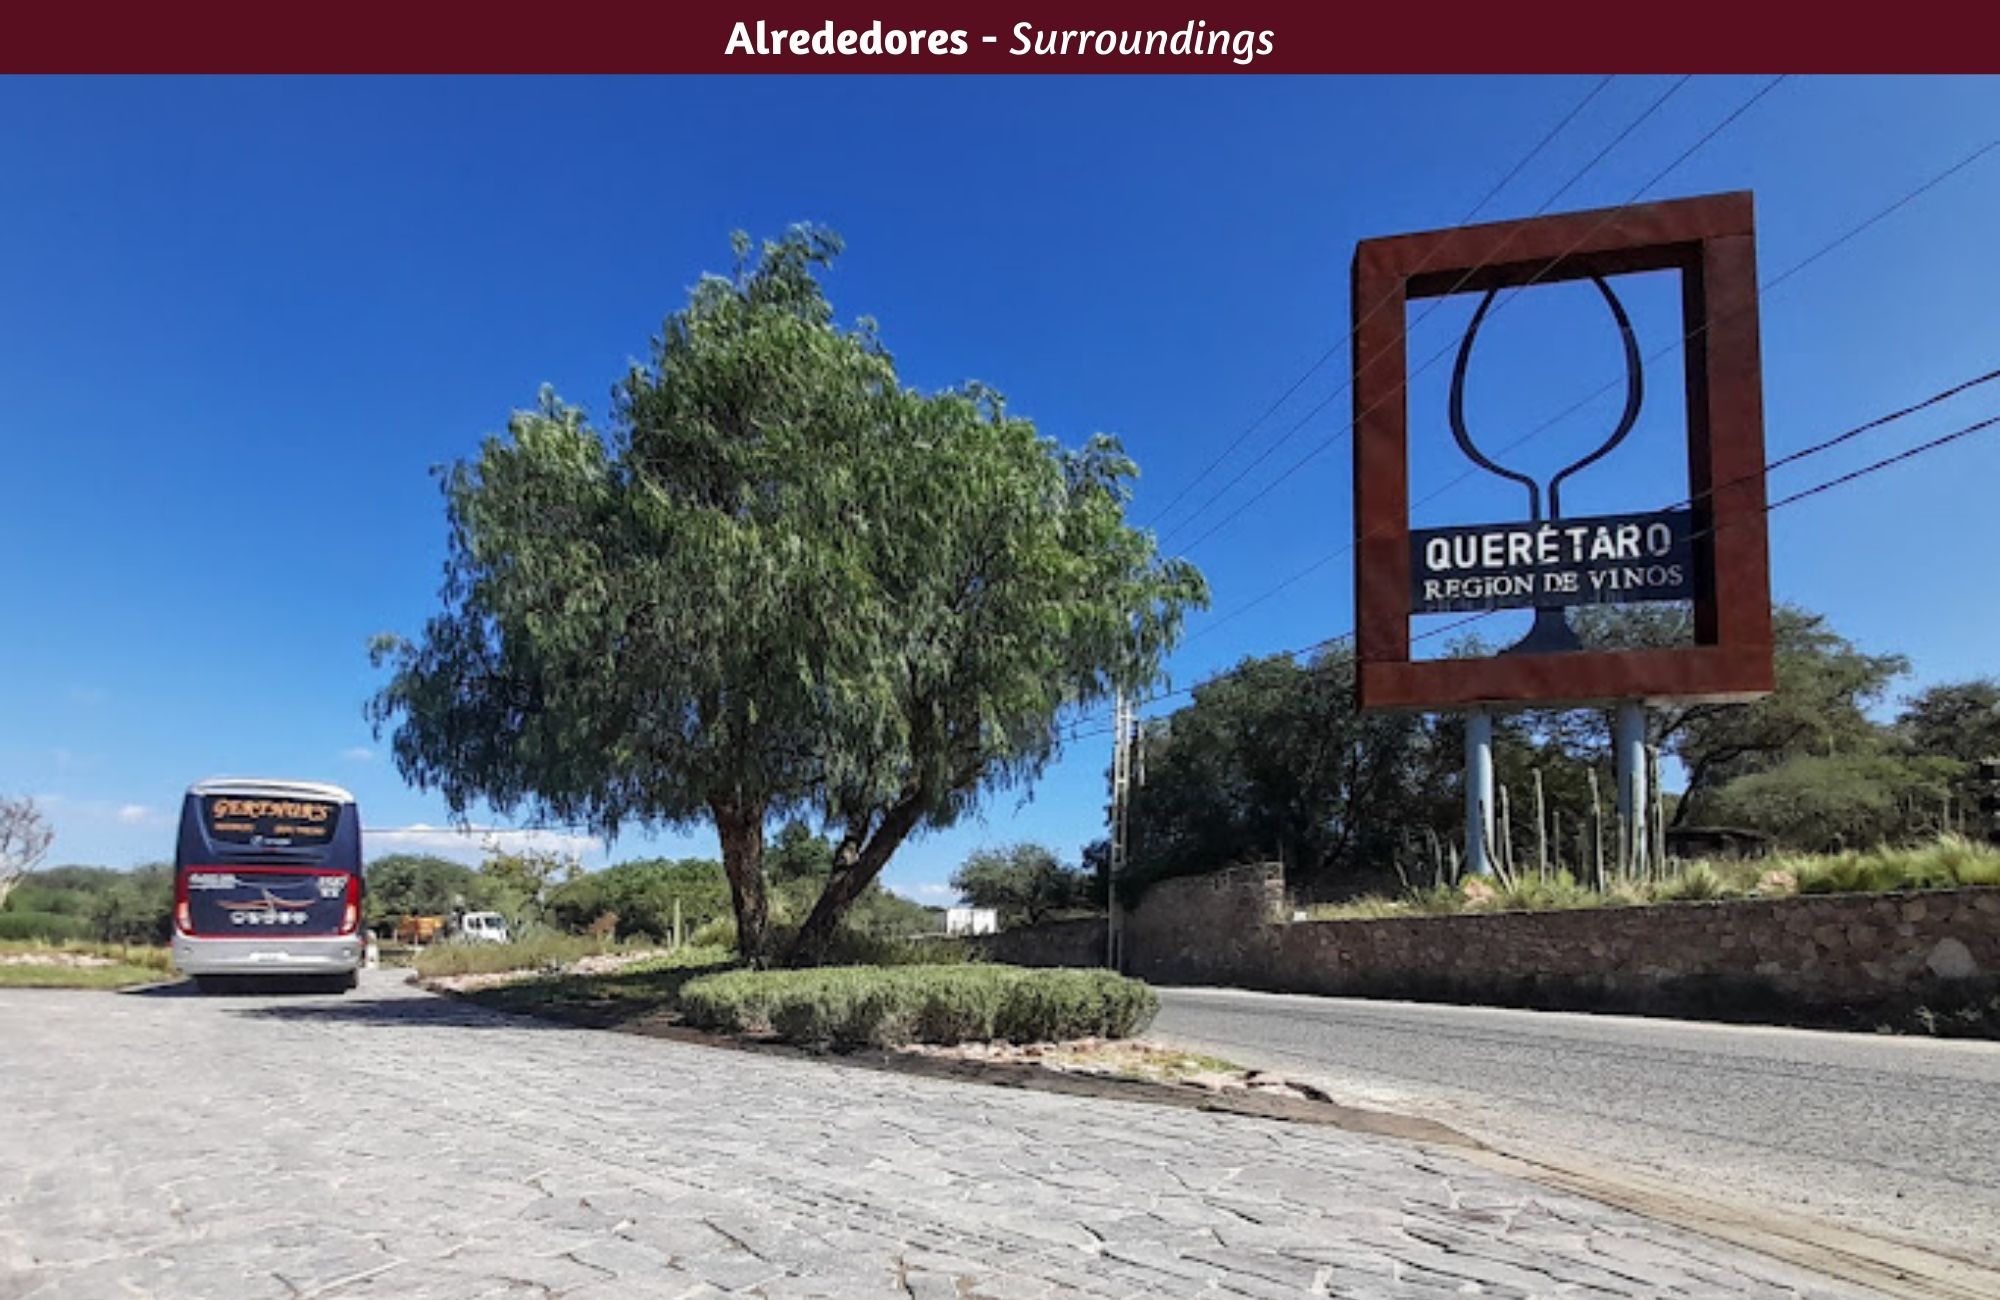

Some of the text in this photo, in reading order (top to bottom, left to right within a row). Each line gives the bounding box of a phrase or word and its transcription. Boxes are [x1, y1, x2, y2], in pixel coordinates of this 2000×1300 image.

[1425, 522, 1672, 572] QUERÉTARO
[1543, 571, 1580, 593] DE
[1587, 564, 1684, 591] VINOS
